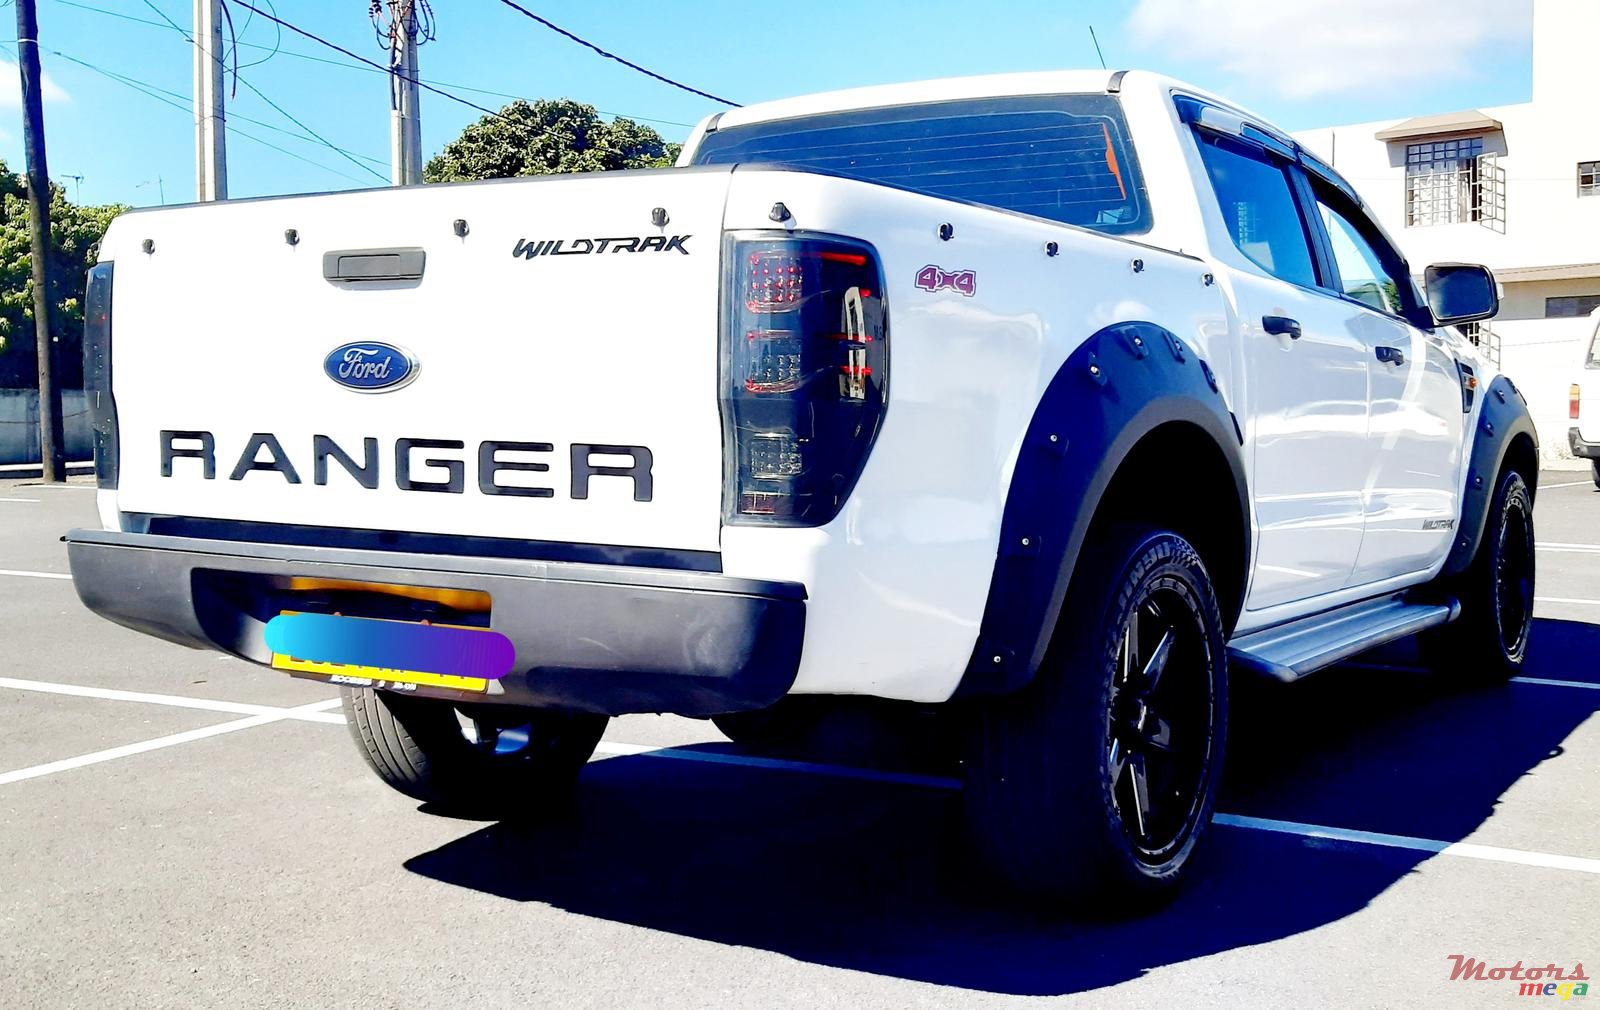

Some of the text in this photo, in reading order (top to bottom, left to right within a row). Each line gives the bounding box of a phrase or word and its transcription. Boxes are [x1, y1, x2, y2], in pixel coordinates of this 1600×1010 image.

[512, 235, 693, 260] WILDTRAK
[339, 347, 392, 379] Ford
[160, 430, 653, 502] RANGER
